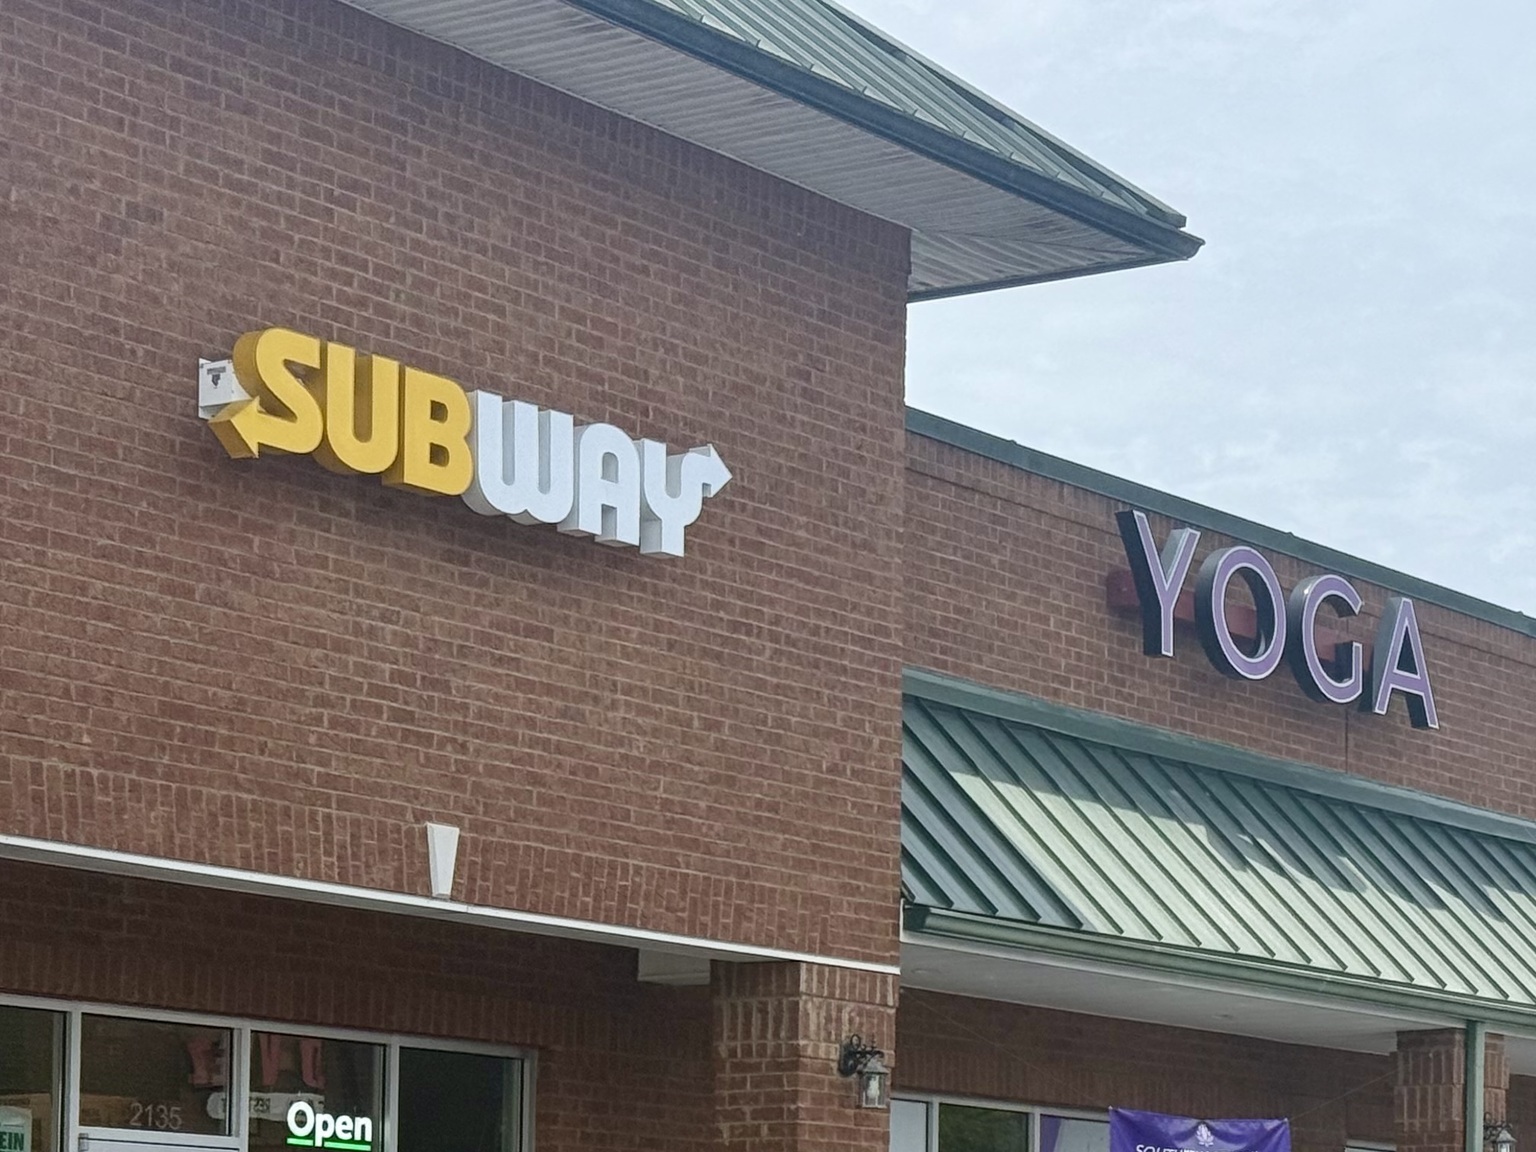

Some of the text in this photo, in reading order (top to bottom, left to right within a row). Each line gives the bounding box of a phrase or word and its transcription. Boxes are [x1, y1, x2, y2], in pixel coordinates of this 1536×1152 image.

[210, 327, 732, 558] SUBWAY
[1117, 509, 1440, 730] YOGA
[129, 1102, 182, 1130] 2135
[286, 1100, 373, 1147] Open
